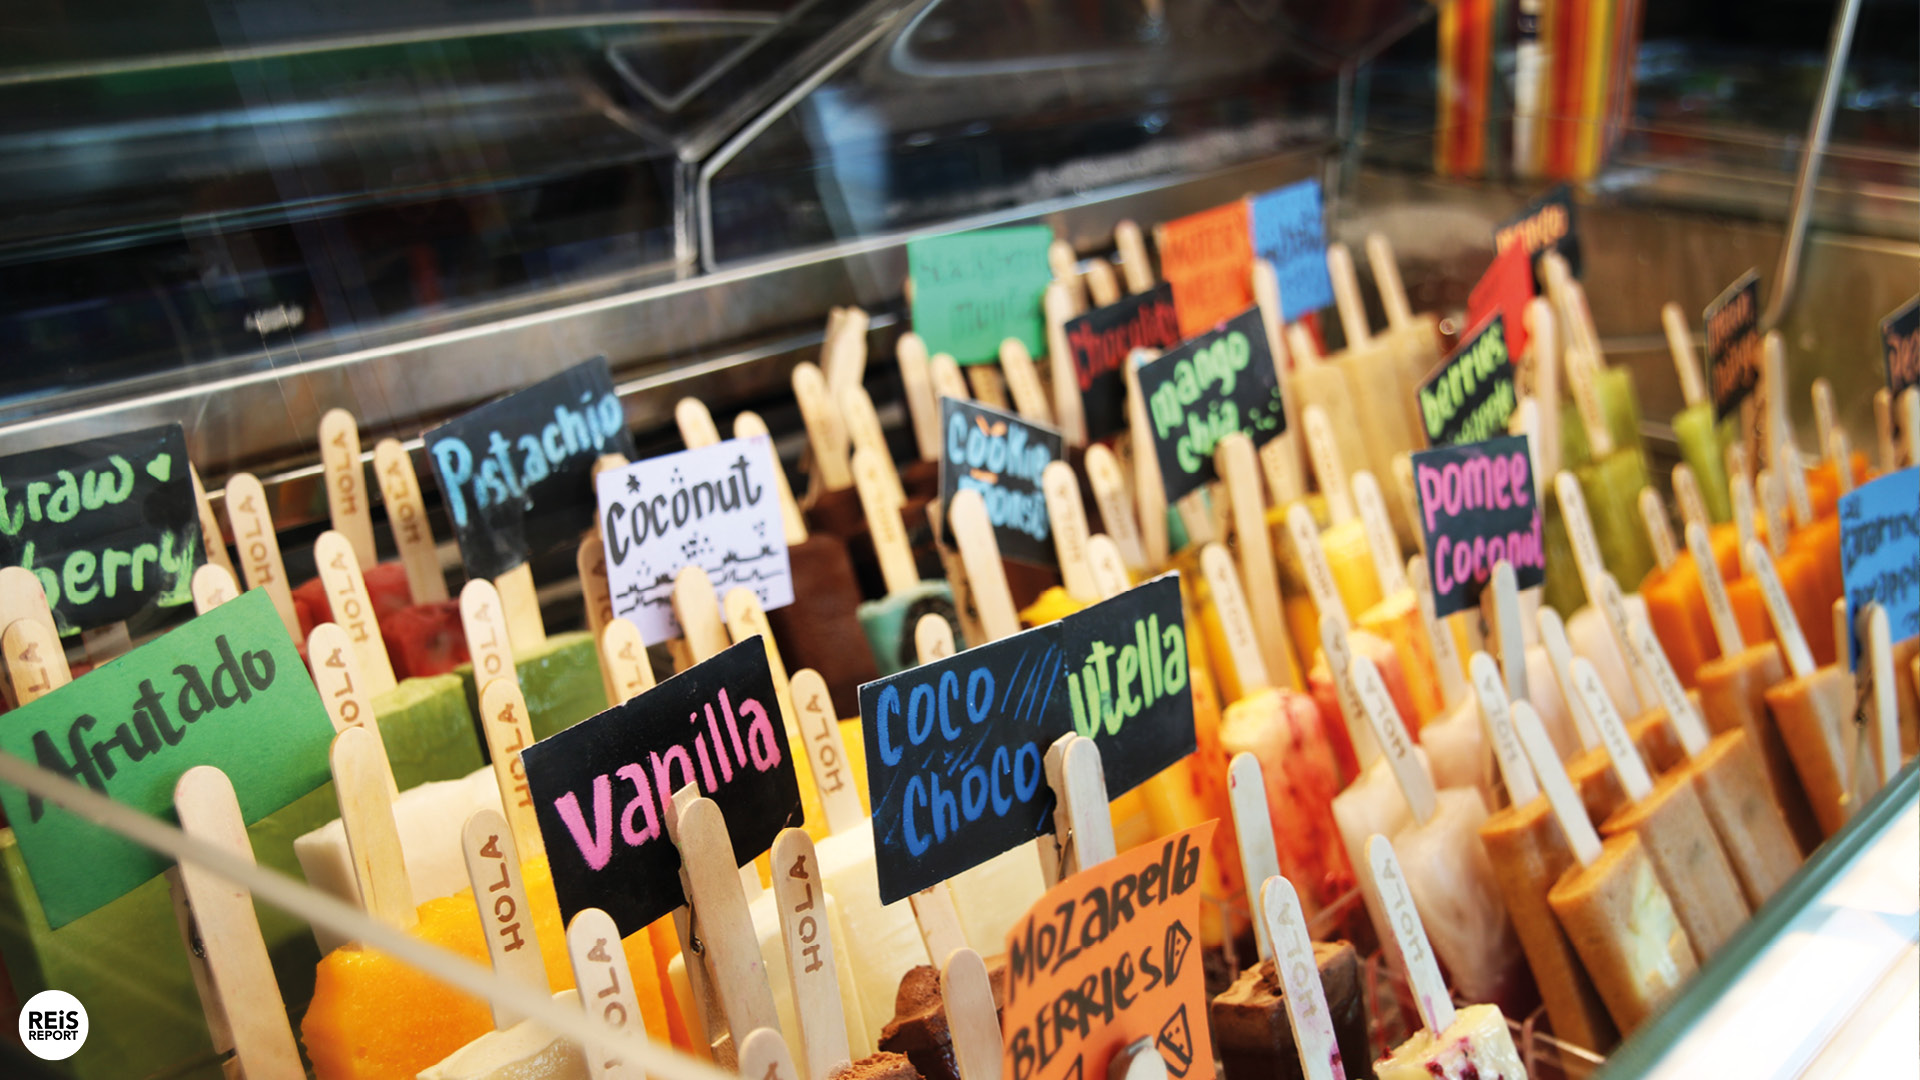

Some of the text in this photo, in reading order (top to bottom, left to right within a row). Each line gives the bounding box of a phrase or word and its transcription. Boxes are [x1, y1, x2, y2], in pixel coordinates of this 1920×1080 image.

[1150, 331, 1250, 440] mango
[1420, 322, 1508, 439] berries
[332, 429, 357, 517] HOLA
[1176, 398, 1240, 474] chia
[238, 493, 276, 587] HOLA
[386, 459, 424, 546] HOLA
[605, 455, 763, 568] Coconut
[331, 551, 371, 645] HOLA
[473, 602, 503, 676] OLA
[18, 641, 52, 695] LA
[325, 647, 365, 728] OLA
[617, 640, 644, 690] LA
[27, 634, 277, 824] Afrutado
[497, 702, 532, 808] HOLA
[806, 692, 846, 796] HOLA
[1366, 676, 1407, 761] HOLA
[479, 833, 526, 953] HOLA
[788, 852, 824, 976] HOLA
[1382, 857, 1425, 962] HOLA
[586, 936, 629, 1071] OLA
[1275, 901, 1318, 1020] HOLA
